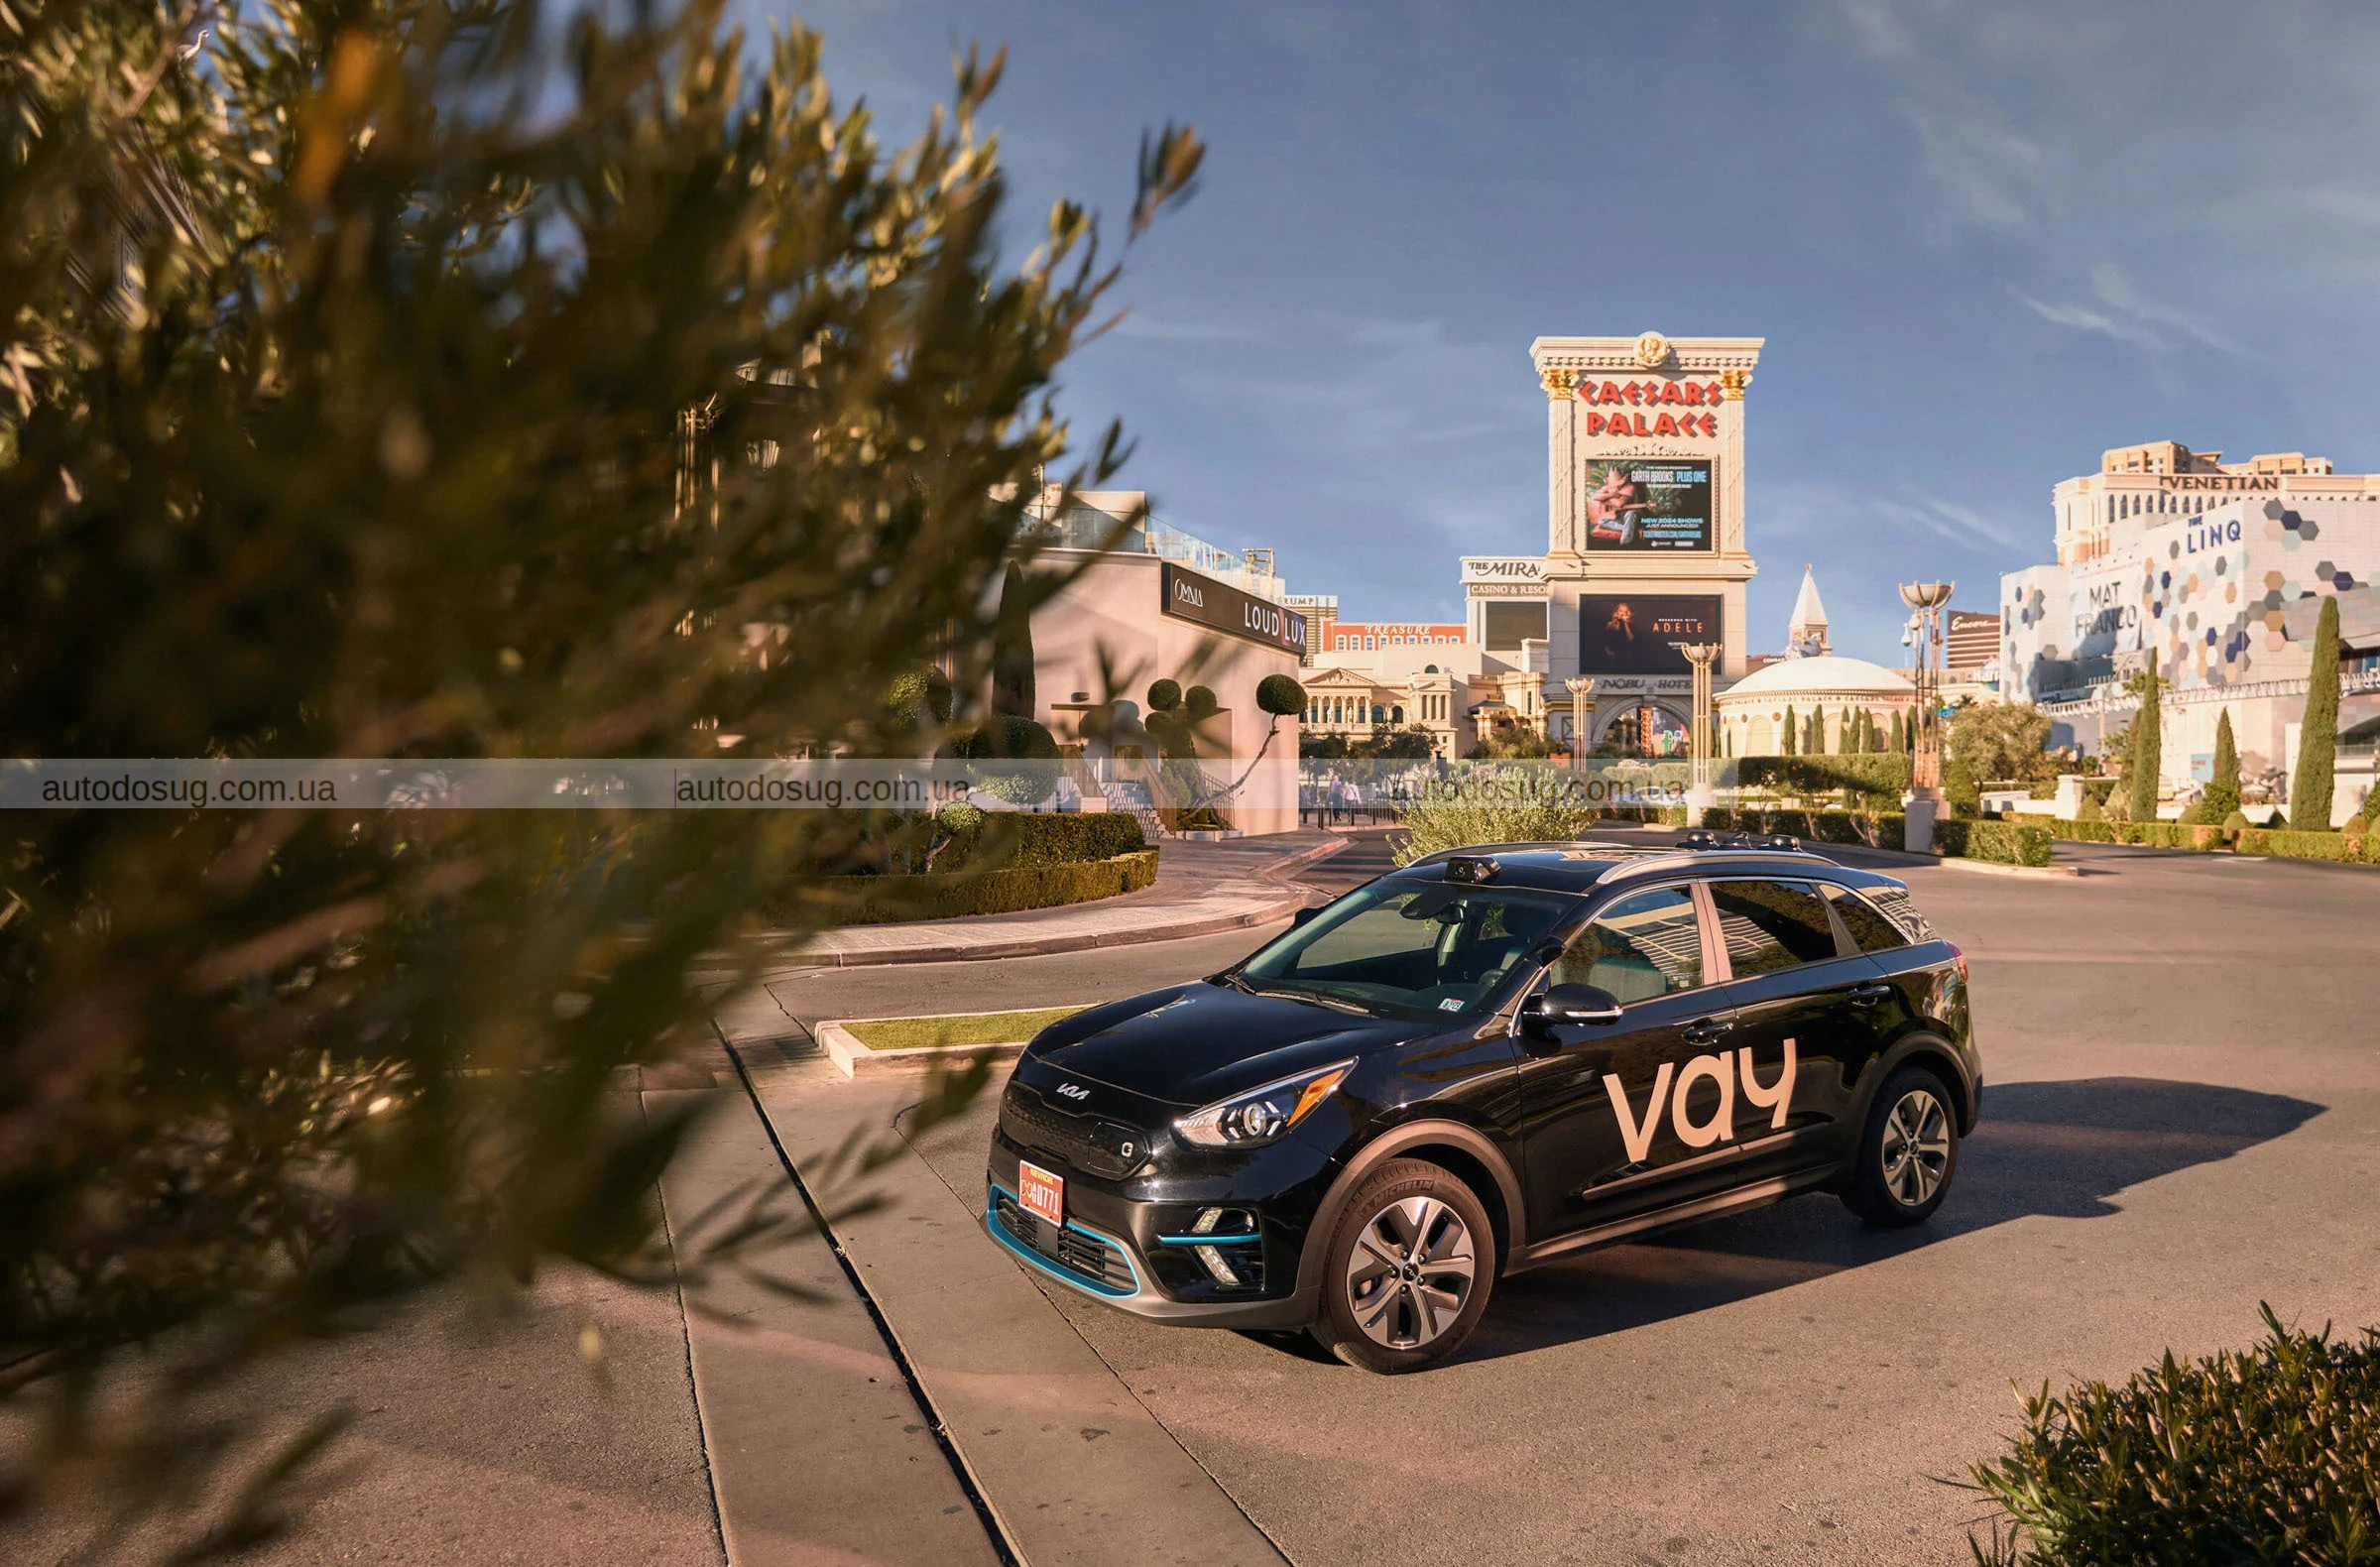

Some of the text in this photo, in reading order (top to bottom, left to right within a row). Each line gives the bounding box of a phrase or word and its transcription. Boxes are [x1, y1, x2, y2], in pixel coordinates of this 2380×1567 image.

[1579, 380, 1724, 407] CAESARS
[1587, 412, 1719, 438] PALACE
[2168, 476, 2278, 491] VENETIAN
[2187, 519, 2241, 553] LINQ
[1469, 561, 1541, 577] THE MIRA
[1471, 585, 1549, 595] CASINO & RESO
[2088, 581, 2122, 609] MAT
[1284, 597, 1315, 606] RUMP
[1245, 601, 1306, 647] LOUD LUX
[1365, 626, 1432, 636] TREASURE
[1652, 622, 1705, 633] ADELE
[1951, 615, 1989, 632] Encore
[2075, 604, 2138, 639] FRANCO
[1601, 677, 1694, 690] NOBU HOTE
[1055, 1082, 1091, 1101] KIA
[1602, 1037, 1797, 1163] vay
[1373, 1179, 1435, 1207] MICHELIN
